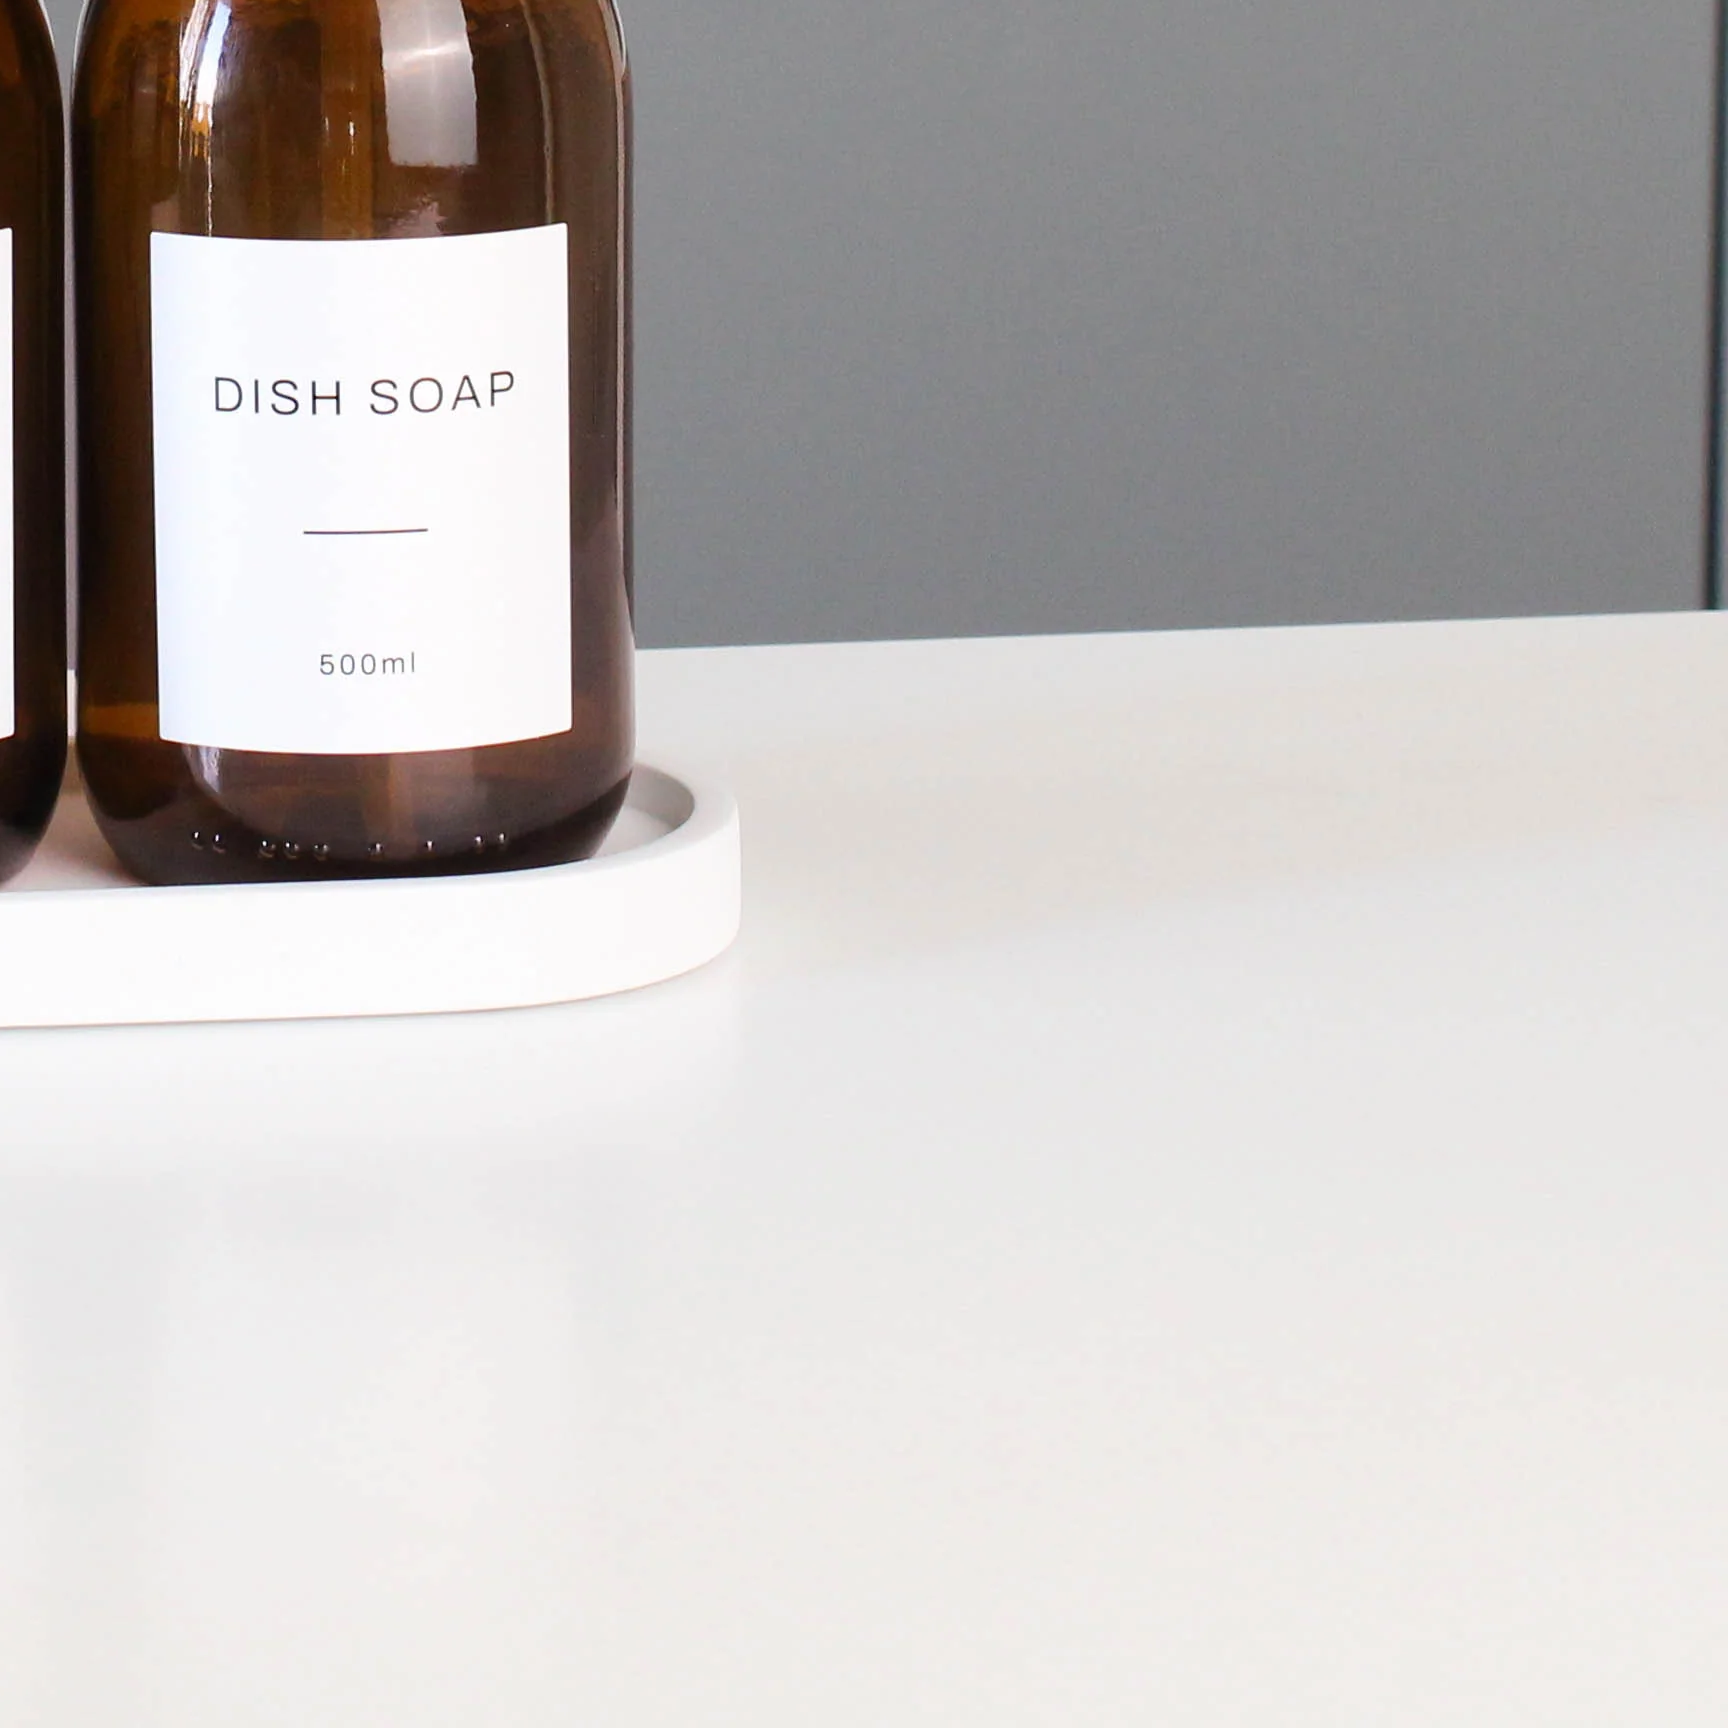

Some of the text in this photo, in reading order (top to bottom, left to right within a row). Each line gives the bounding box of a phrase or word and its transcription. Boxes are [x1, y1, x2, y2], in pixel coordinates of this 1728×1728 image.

[214, 370, 515, 416] DISH SOAP
[319, 652, 416, 676] 500ml
